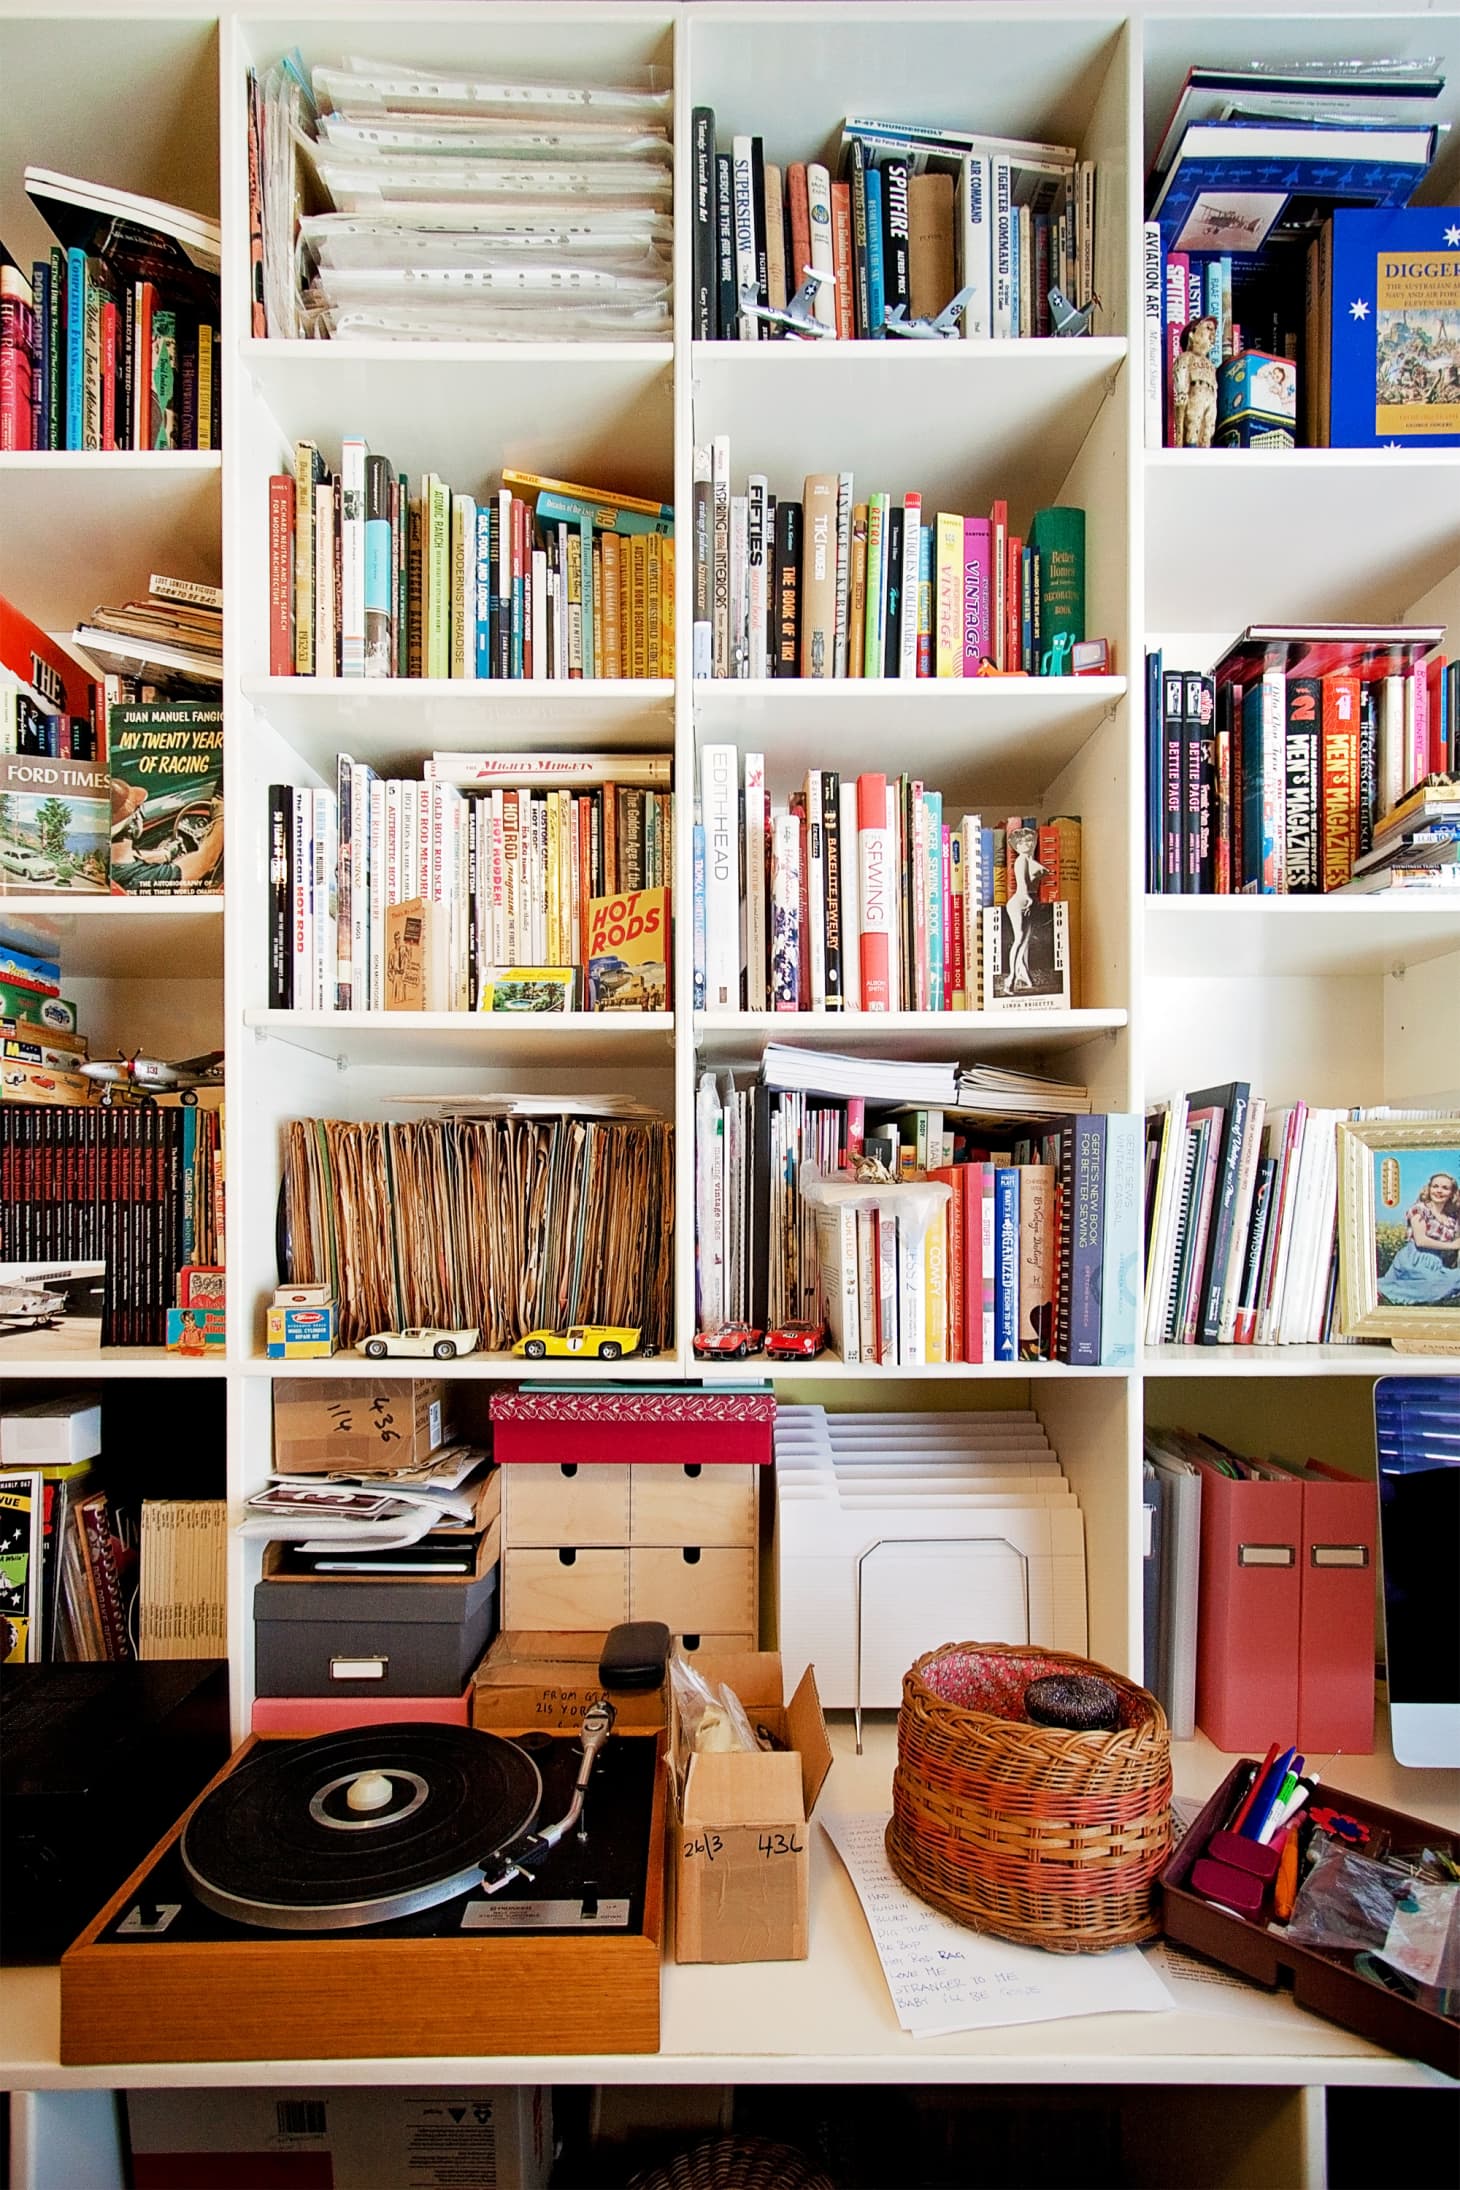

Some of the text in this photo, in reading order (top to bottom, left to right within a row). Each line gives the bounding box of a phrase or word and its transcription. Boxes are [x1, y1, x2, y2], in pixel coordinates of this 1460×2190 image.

[720, 160, 732, 282] AMERICA IN THE AIR WAR
[735, 160, 751, 254] SUPERSHOW
[888, 166, 909, 240] SPITFIRE
[970, 160, 982, 224] AIR COMMAND
[998, 165, 1009, 274] FIGHTER COMMAND
[837, 211, 849, 308] The Golden Age of Air
[897, 250, 906, 295] ALFRED PRICE
[1146, 232, 1158, 319] AVIATION ART
[0, 303, 14, 358] HEART
[71, 329, 81, 365] FRANK
[86, 348, 98, 376] Jane
[86, 385, 98, 431] Michael
[434, 490, 443, 548] ATOMIC RANCH
[715, 481, 726, 608] INSPIRING INTERIORS
[750, 485, 762, 566] FIFTIES
[837, 482, 848, 549] VINTAGE
[871, 507, 880, 546] RETRO
[906, 522, 919, 571] ANTIQUES
[634, 546, 644, 586] AUSTRALIAN
[650, 559, 658, 594] COMPLETE
[455, 543, 465, 663] MODERNIST PARADISE
[634, 611, 644, 649] DECORATOR
[782, 566, 795, 661] THE BOOK OF TIKI
[941, 566, 952, 649] VINTAGE
[965, 560, 980, 659] VINTAGE
[30, 651, 65, 705] THE
[1290, 695, 1316, 721] 2
[120, 731, 224, 749] MY TWENTY YEAR
[124, 711, 148, 722] JUAN
[152, 711, 190, 722] MANUEL
[8, 765, 111, 789] FORD TIMES
[139, 755, 210, 774] OF RACING
[1169, 741, 1179, 812] BETTIE PAGE
[1189, 742, 1199, 813] BETTIE PAGE
[420, 790, 429, 844] HOT ROD
[433, 796, 443, 871] OLD HOT ROD
[626, 791, 640, 888] The Golden Age of the
[1287, 734, 1309, 886] MEN'S MAGAZINES
[1326, 734, 1349, 886] MEN'S MAGAZINES
[388, 805, 396, 884] AUTHENTIC HOT
[504, 803, 517, 916] HOT ROD magazine
[713, 816, 728, 881] HEAD
[928, 811, 938, 937] SINGER SEWING BOOK
[592, 893, 642, 932] HOT
[827, 838, 837, 951] BAKELITE JEWELRY
[864, 840, 883, 921] SEWING
[591, 907, 661, 956] RODS
[1079, 1133, 1090, 1248] FOR BETTER SEWING
[1089, 1133, 1099, 1246] GERTIE'S NEW BOOK
[929, 1245, 941, 1297] COMFY
[543, 1690, 577, 1700] FROM
[561, 1704, 588, 1716] YOR
[758, 1833, 803, 1859] 436
